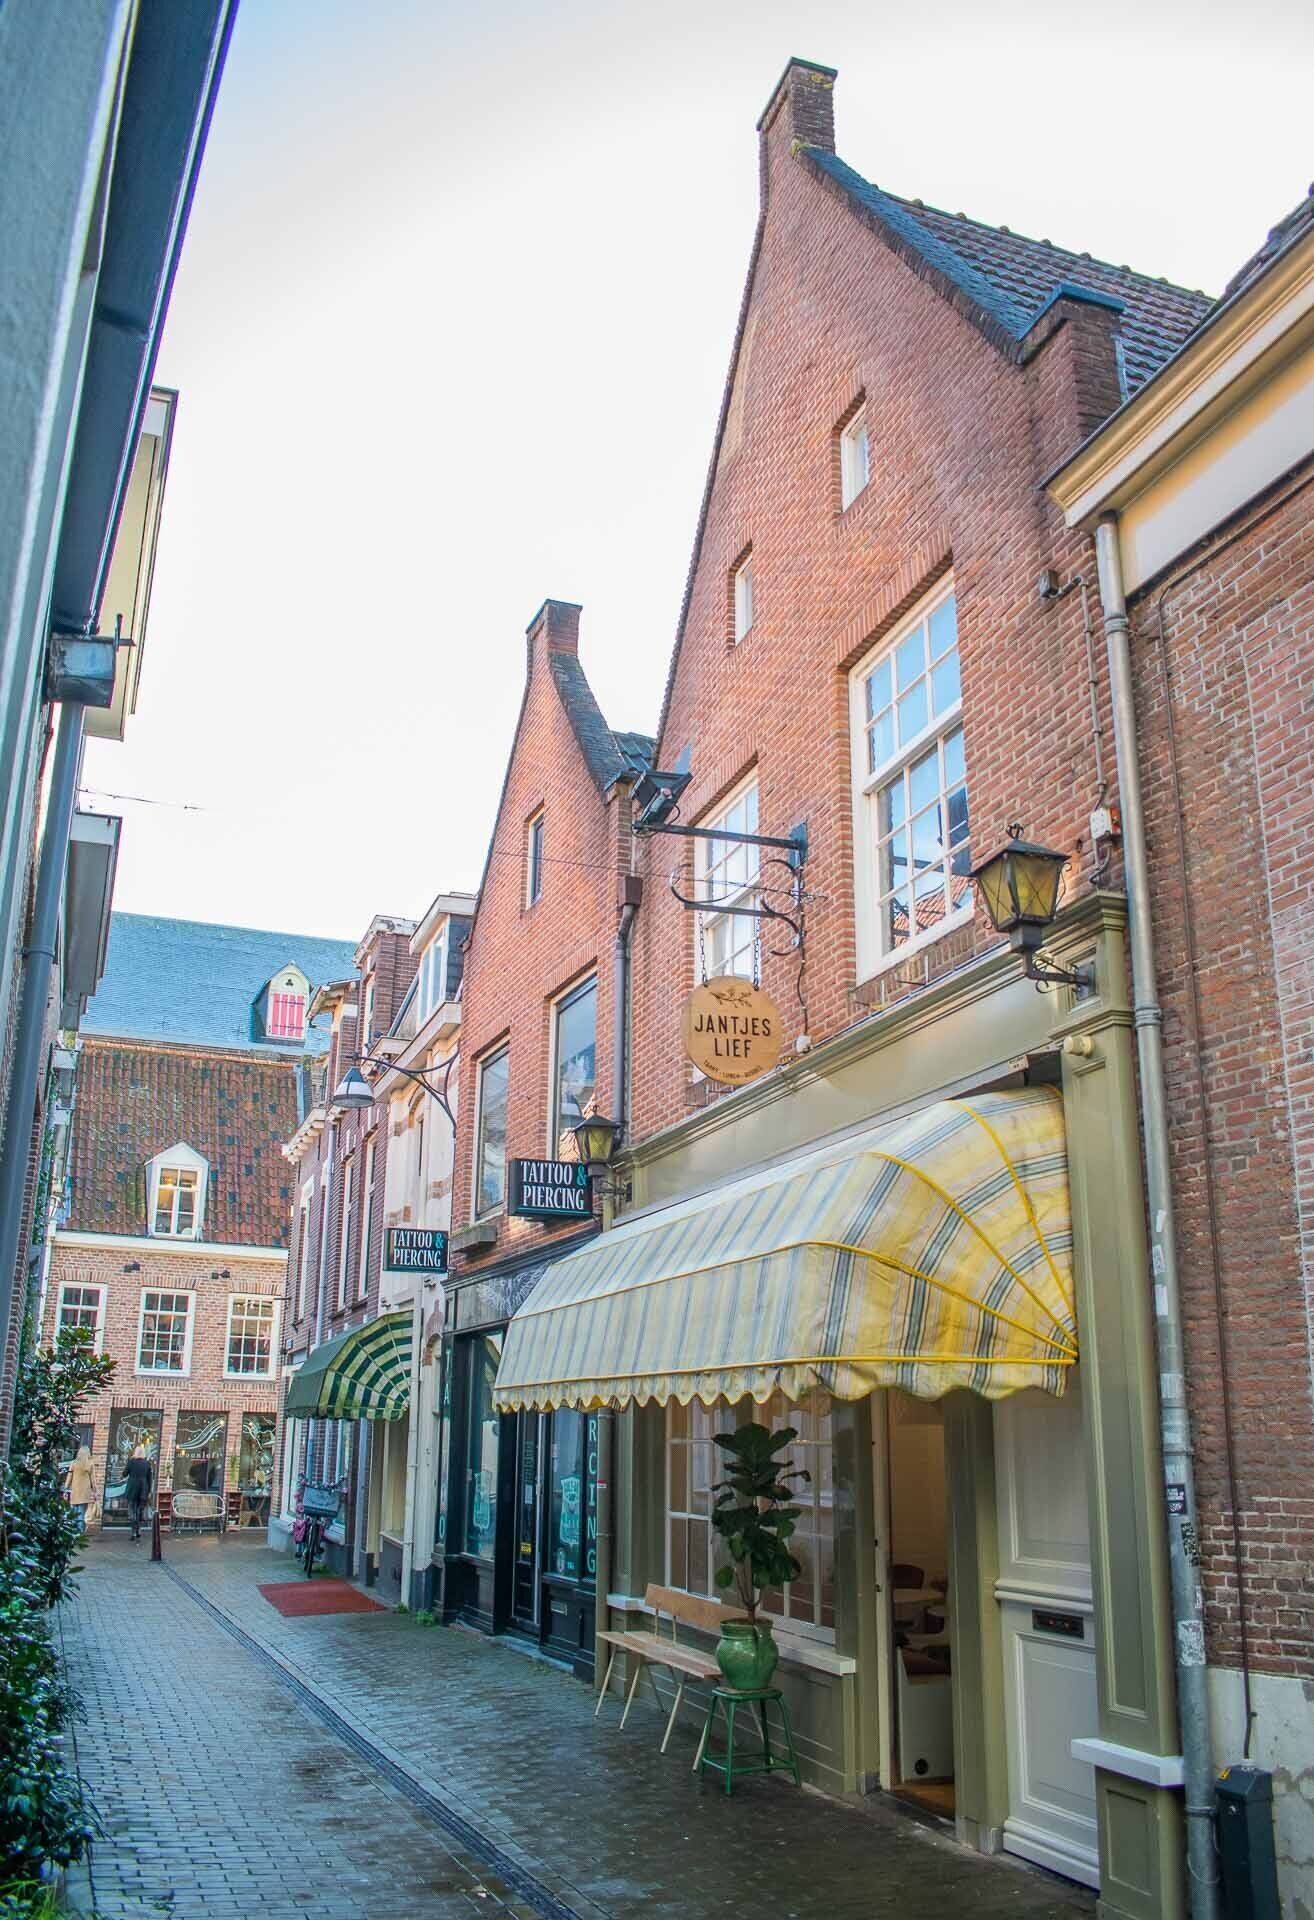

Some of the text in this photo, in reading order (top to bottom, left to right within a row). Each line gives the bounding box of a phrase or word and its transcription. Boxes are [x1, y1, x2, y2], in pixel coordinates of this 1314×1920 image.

[694, 1013, 771, 1037] JANTJES
[714, 1038, 752, 1058] LIEF
[521, 1161, 586, 1186] TATTOO &
[523, 1185, 585, 1210] PIERCING
[391, 1230, 444, 1249] TATTOO &
[393, 1248, 441, 1267] PIERCING
